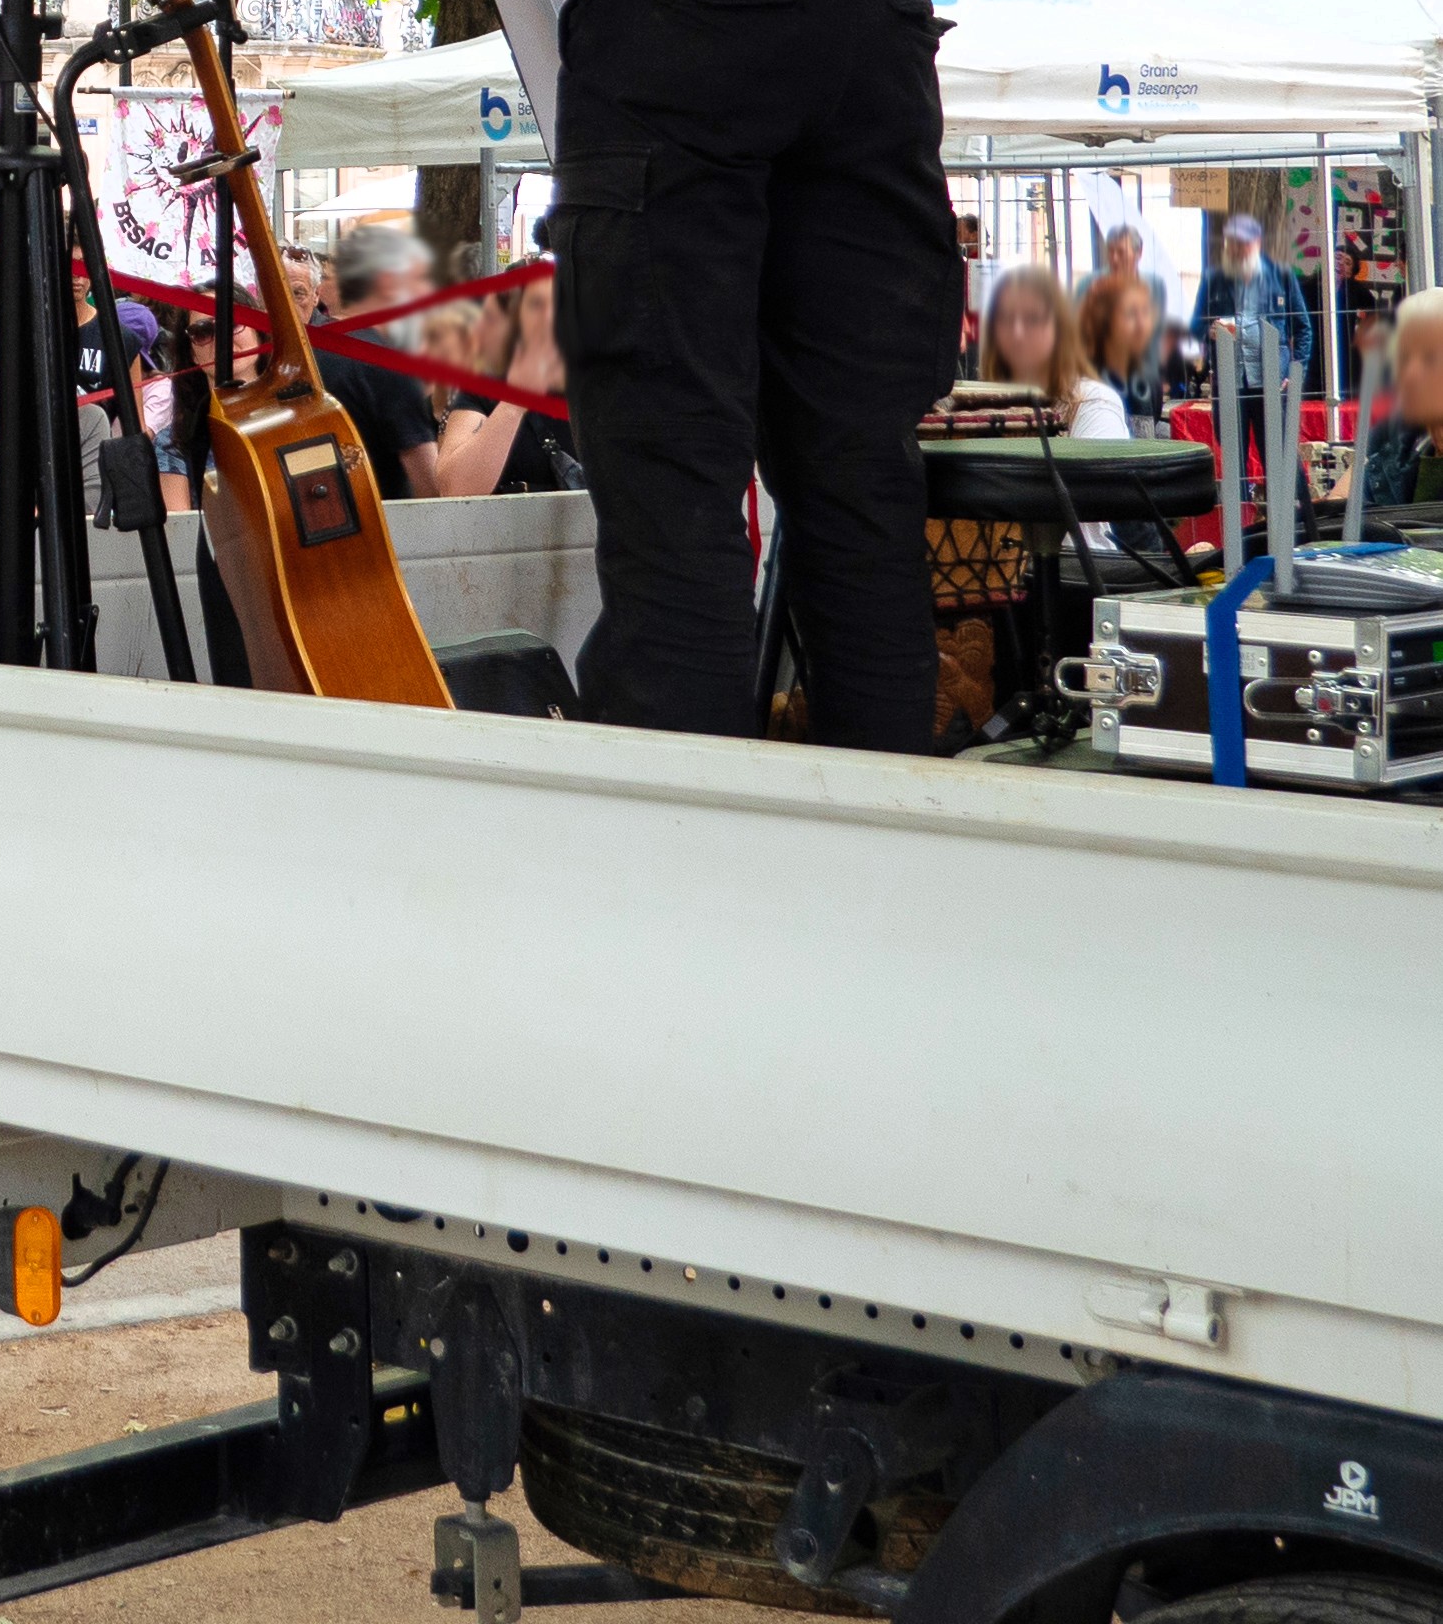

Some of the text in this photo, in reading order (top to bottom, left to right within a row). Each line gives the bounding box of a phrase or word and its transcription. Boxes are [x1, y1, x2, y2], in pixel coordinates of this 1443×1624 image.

[1139, 63, 1178, 78] Grand
[1137, 81, 1199, 100] Besançon
[113, 200, 173, 260] BESAC
[1324, 1486, 1376, 1514] JPM
